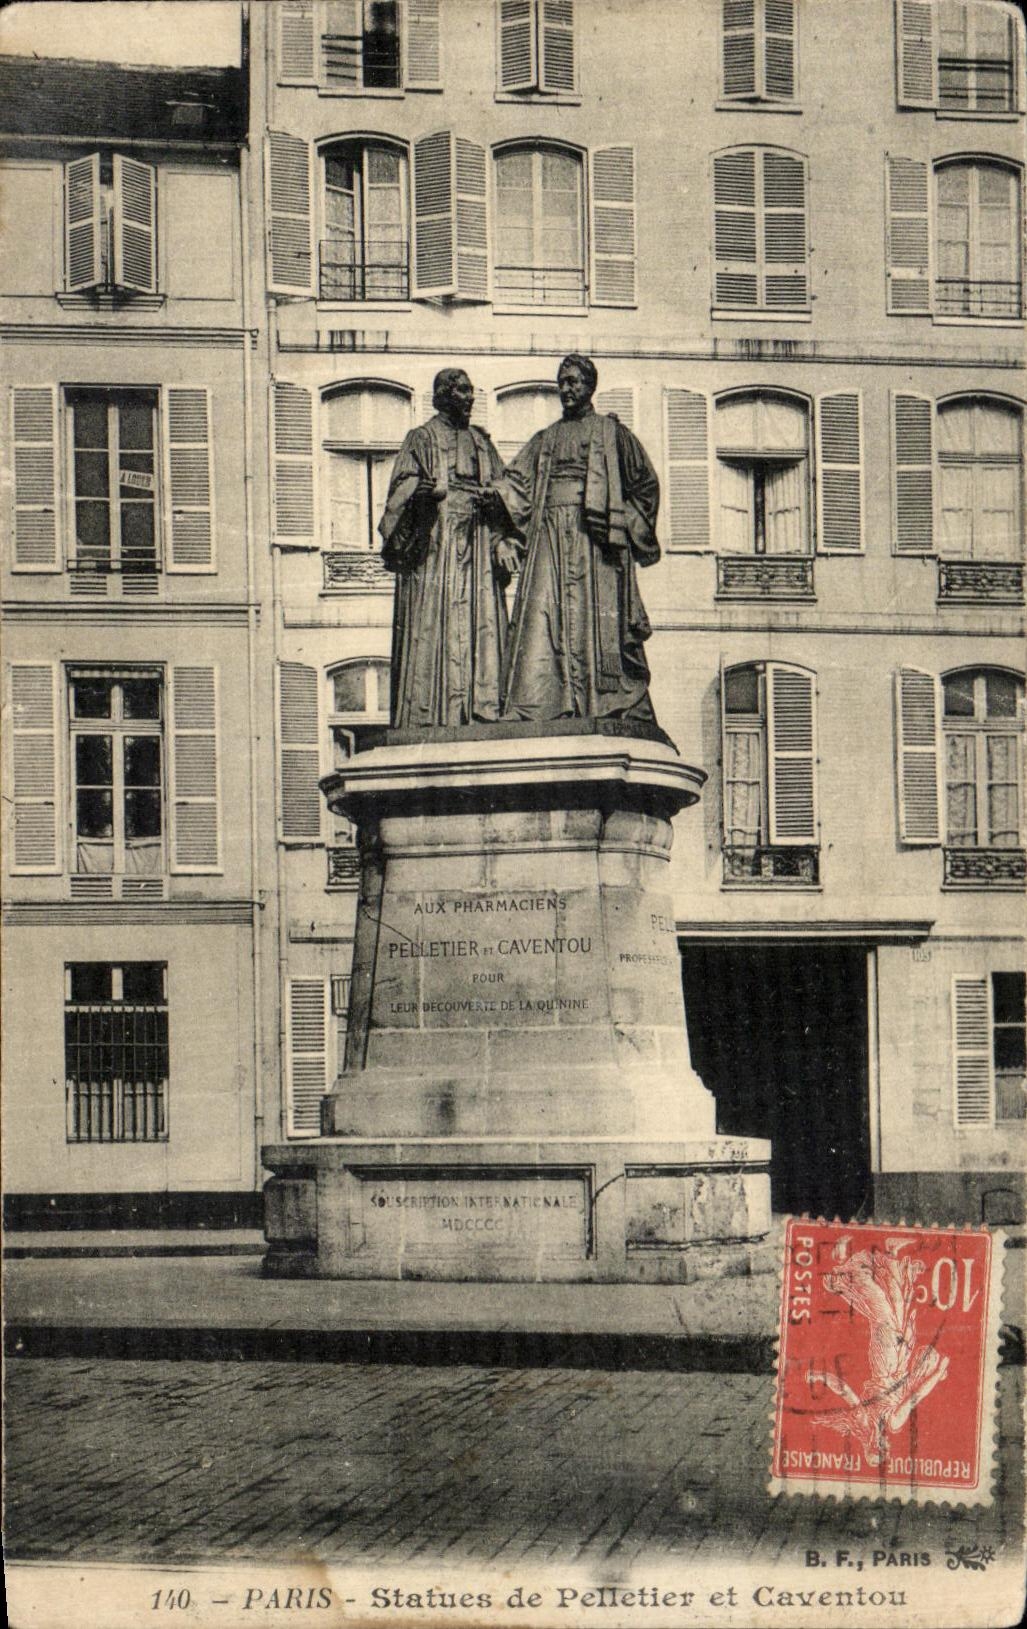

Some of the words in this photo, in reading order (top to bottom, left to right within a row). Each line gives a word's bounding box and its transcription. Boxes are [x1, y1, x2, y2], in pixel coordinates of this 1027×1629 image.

[414, 901, 446, 915] AUX
[453, 899, 567, 913] PHARMACIENS
[389, 940, 479, 958] PELLETIER
[498, 938, 591, 955] CAVENTOU
[472, 973, 505, 984] POUR
[391, 1002, 418, 1013] LEUR
[500, 1000, 515, 1011] DE
[520, 1000, 533, 1011] LA
[537, 999, 589, 1012] QUININE
[792, 1236, 814, 1321] POSTES
